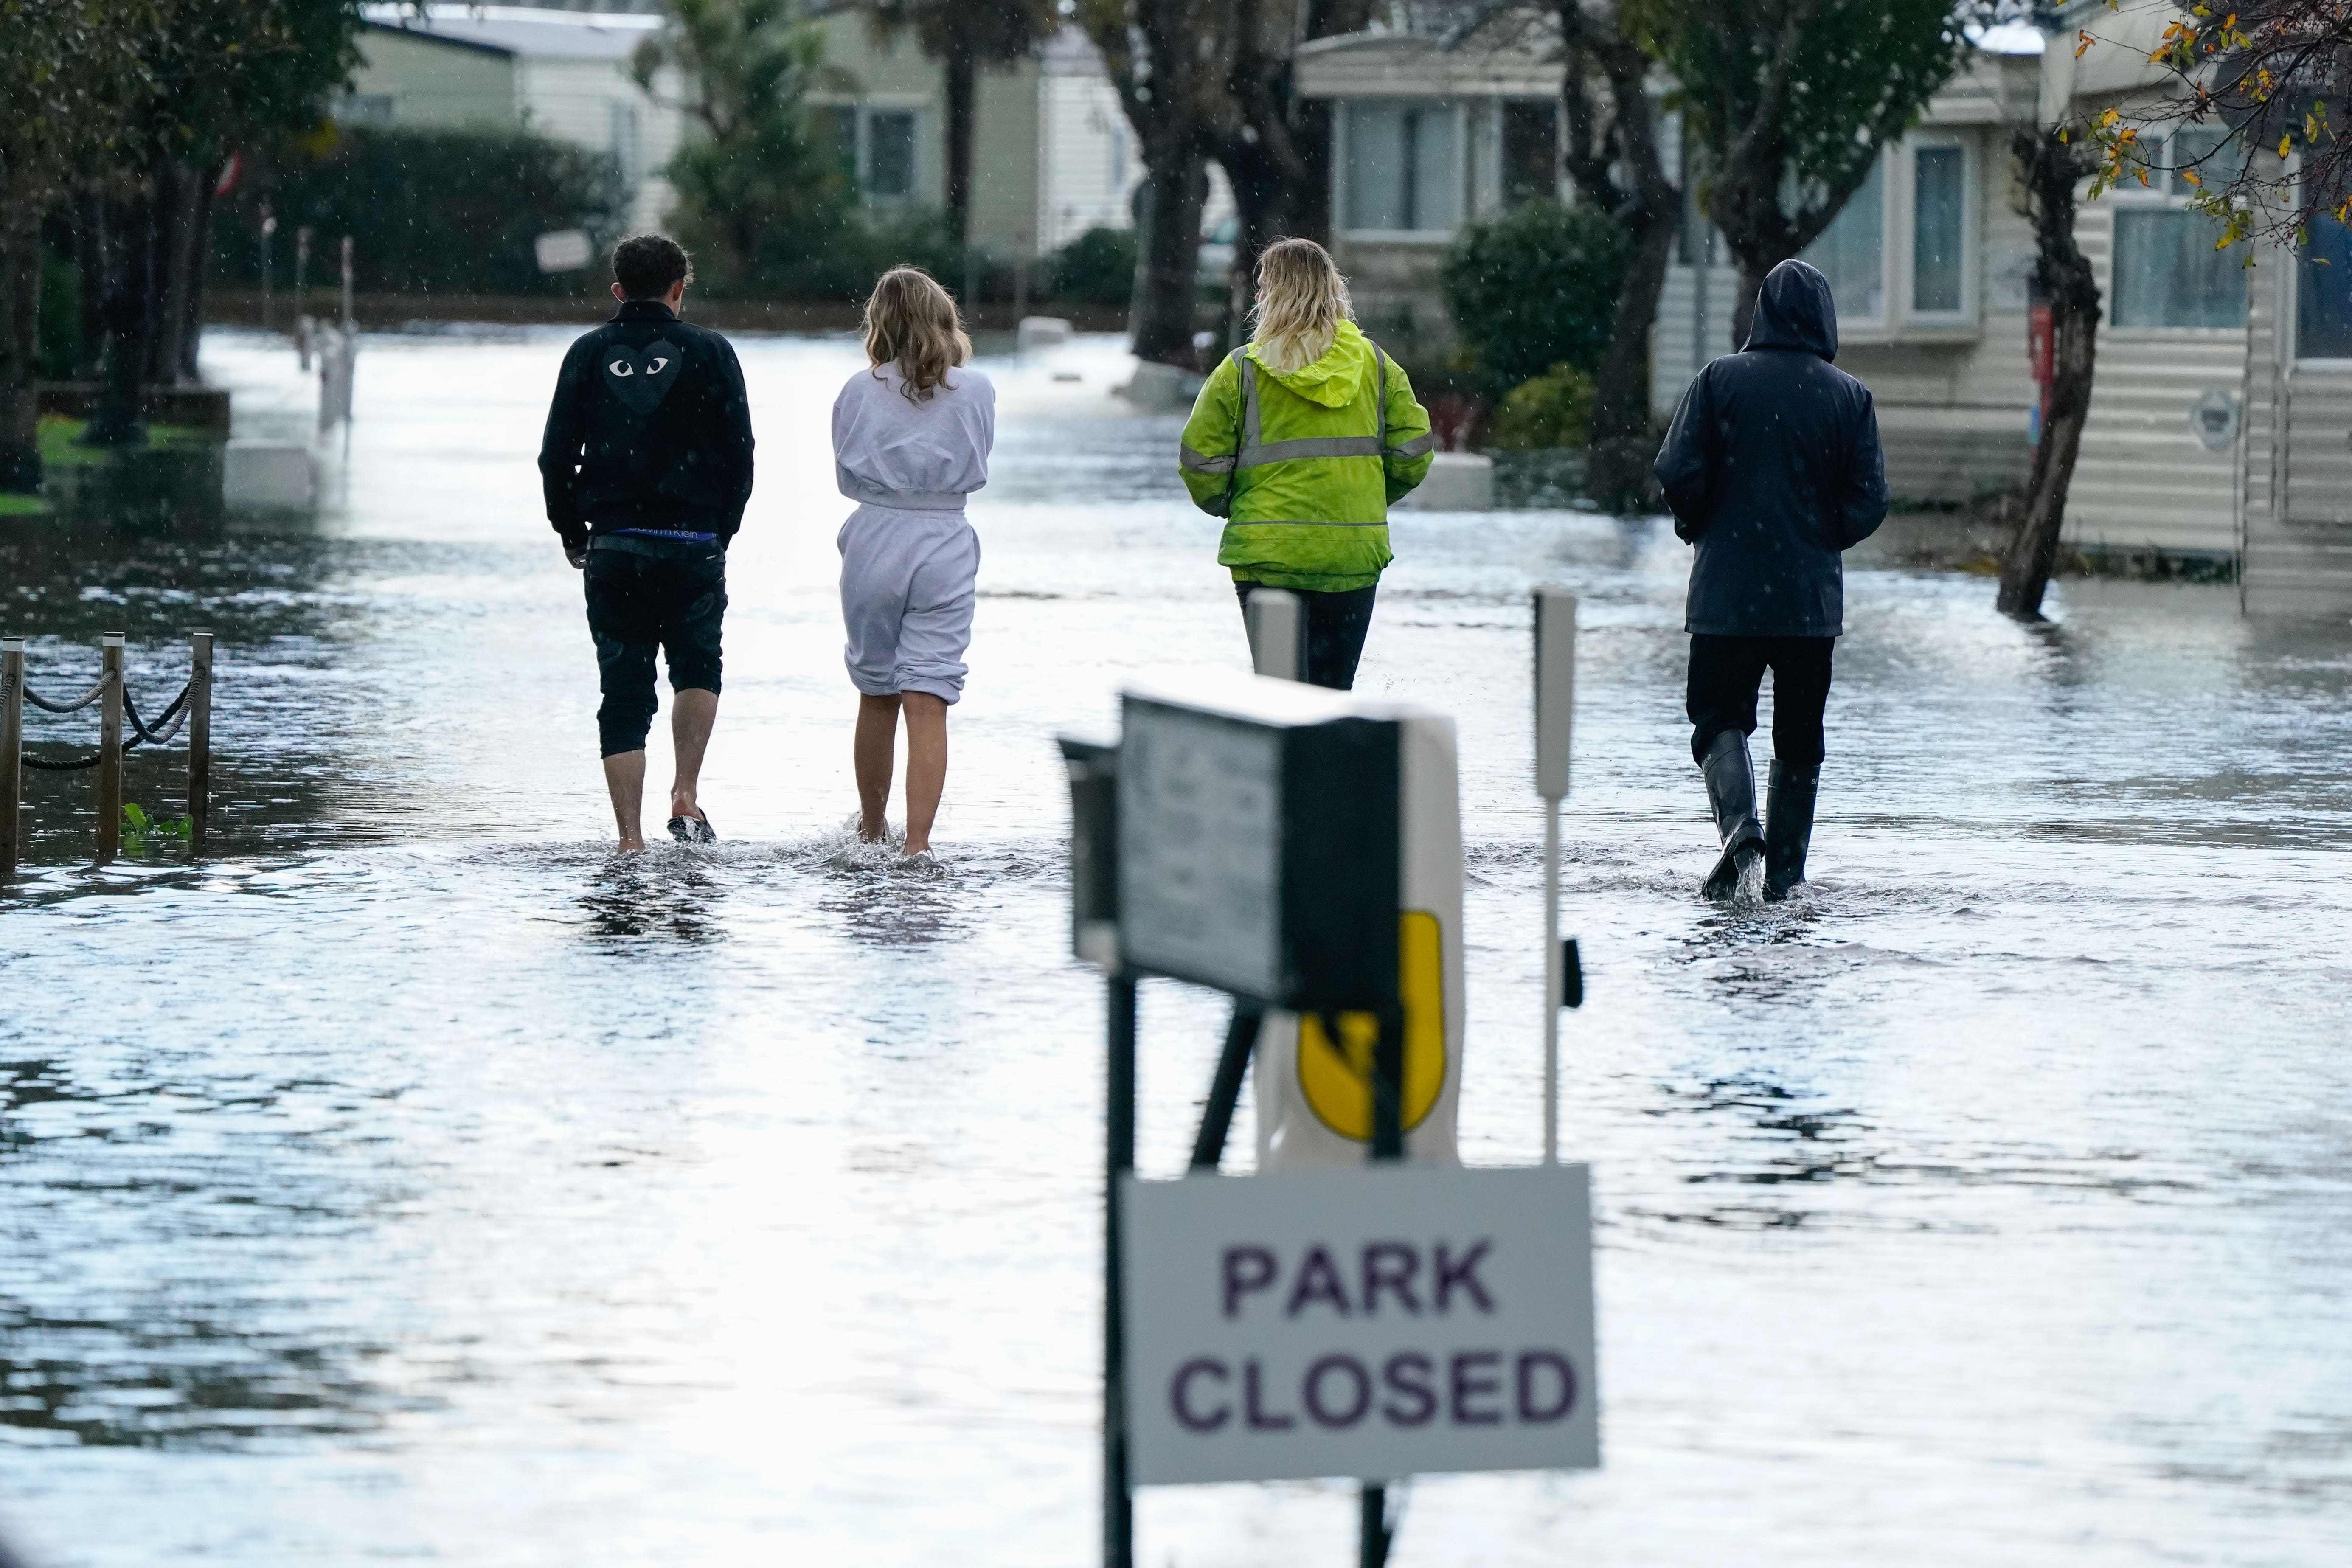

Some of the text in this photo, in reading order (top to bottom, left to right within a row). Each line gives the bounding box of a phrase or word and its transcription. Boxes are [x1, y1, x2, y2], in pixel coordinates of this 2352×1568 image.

[673, 529, 698, 538] Klein
[1220, 1239, 1495, 1320] PARK
[1169, 1349, 1578, 1433] CLOSED
